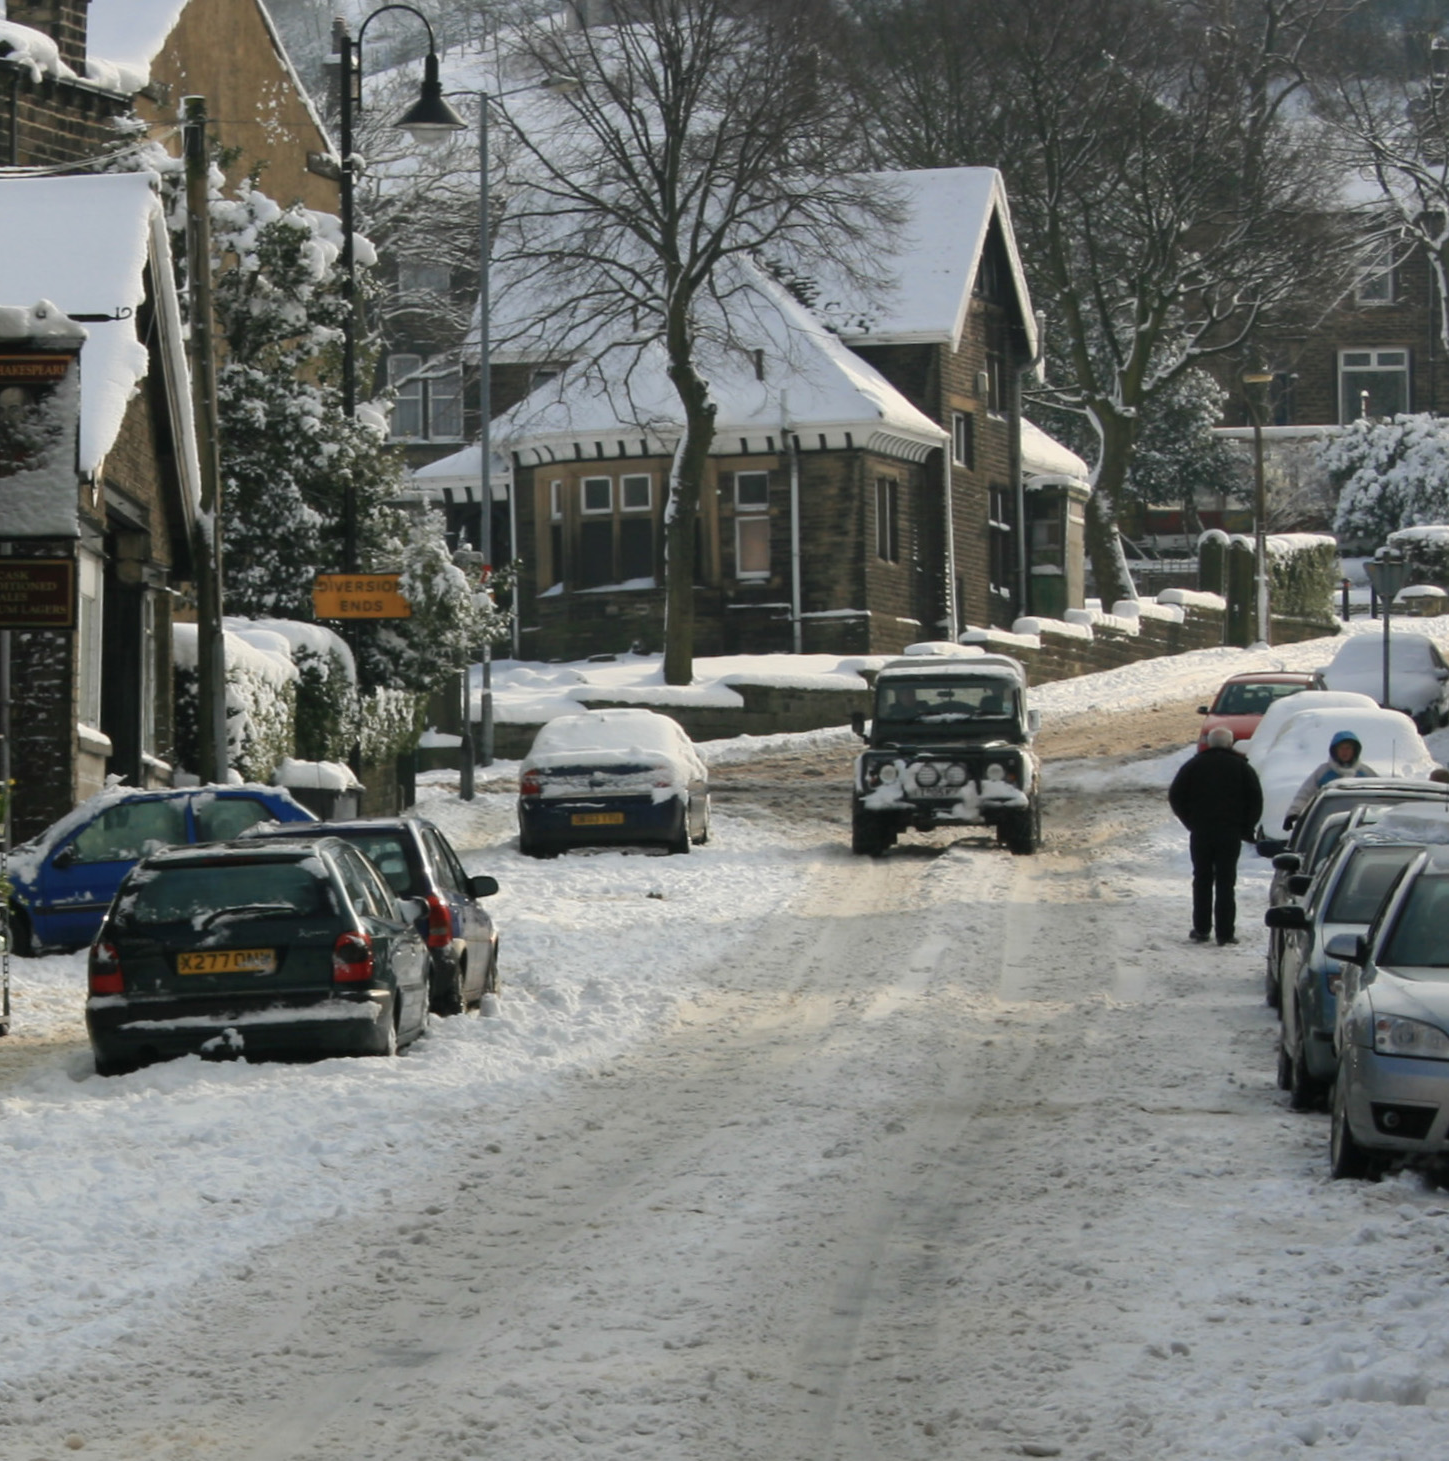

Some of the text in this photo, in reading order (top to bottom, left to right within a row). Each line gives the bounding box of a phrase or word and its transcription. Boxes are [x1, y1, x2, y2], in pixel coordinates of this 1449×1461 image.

[21, 603, 67, 615] LAGERS
[339, 600, 384, 612] ENDS
[180, 952, 229, 971] X277
